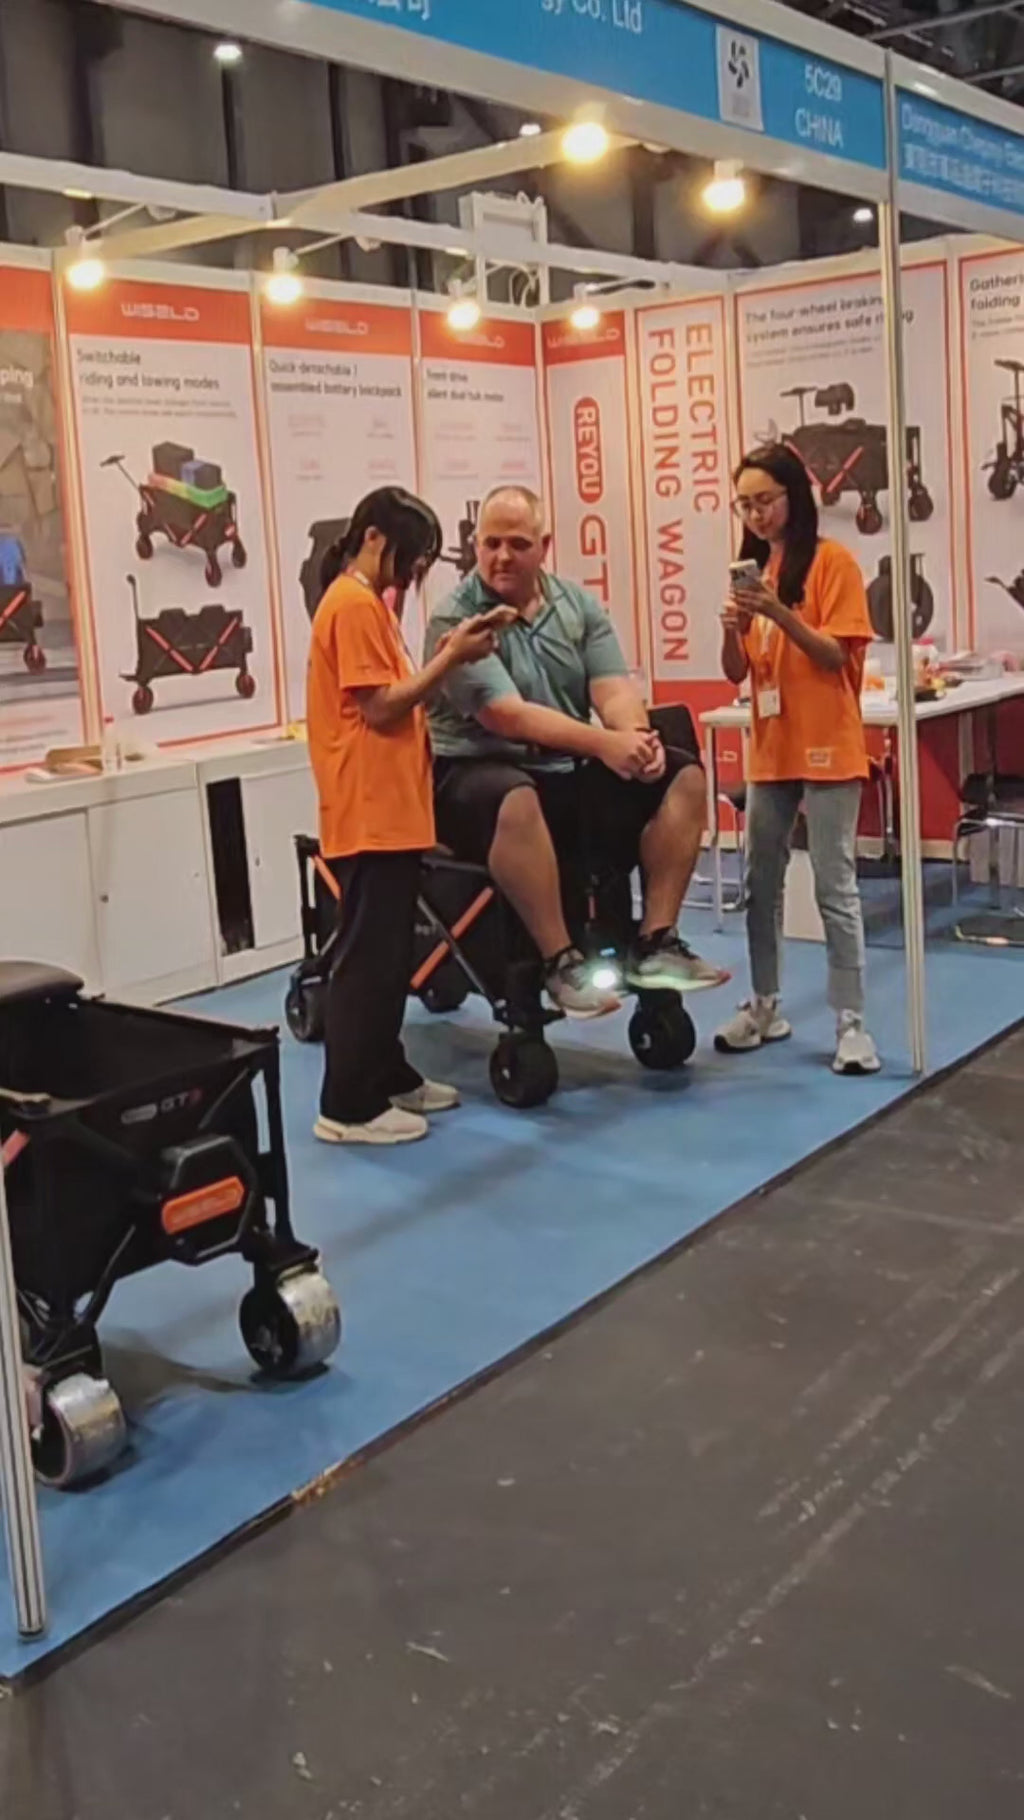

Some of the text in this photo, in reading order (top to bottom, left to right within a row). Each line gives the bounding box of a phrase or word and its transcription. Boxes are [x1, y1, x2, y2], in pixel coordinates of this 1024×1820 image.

[612, 0, 643, 34] Ltd
[794, 107, 844, 148] CHINA
[791, 320, 841, 337] ensures
[845, 313, 872, 329] safe
[117, 374, 139, 387] and
[184, 374, 220, 390] modes
[576, 406, 602, 495] REYOU
[686, 323, 720, 514] ELECTRIC
[649, 327, 690, 662] FOLDING WAGON
[580, 514, 610, 615] GT
